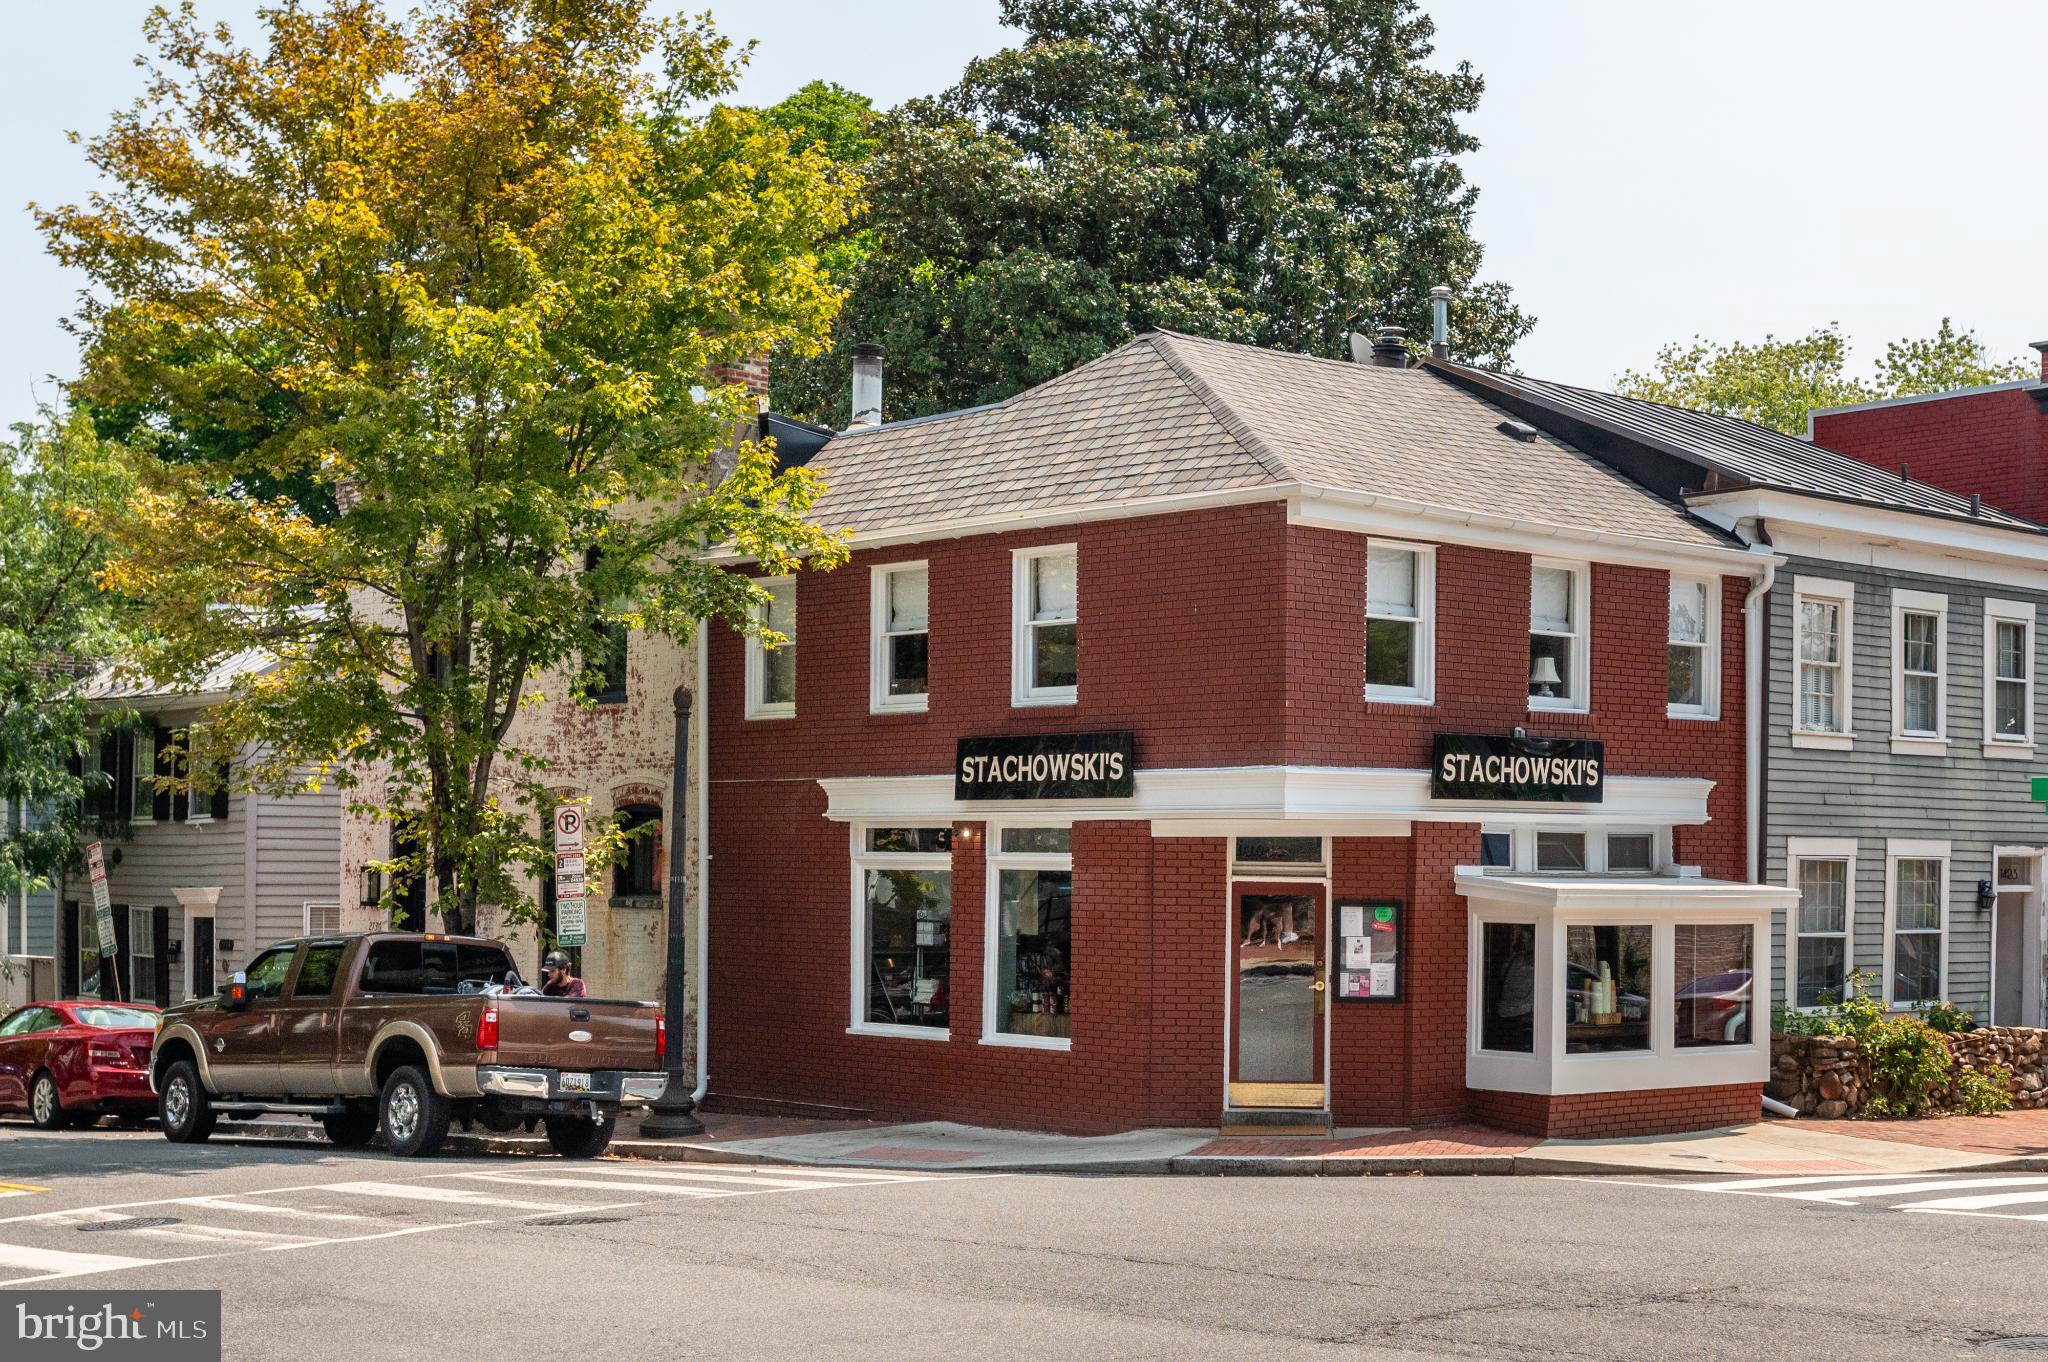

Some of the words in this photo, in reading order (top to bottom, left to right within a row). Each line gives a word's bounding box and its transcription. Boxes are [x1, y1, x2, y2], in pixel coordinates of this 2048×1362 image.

[961, 752, 1124, 783] STACHOWSKI'S
[1442, 753, 1599, 786] STACHOWSKI'S
[565, 815, 576, 831] P
